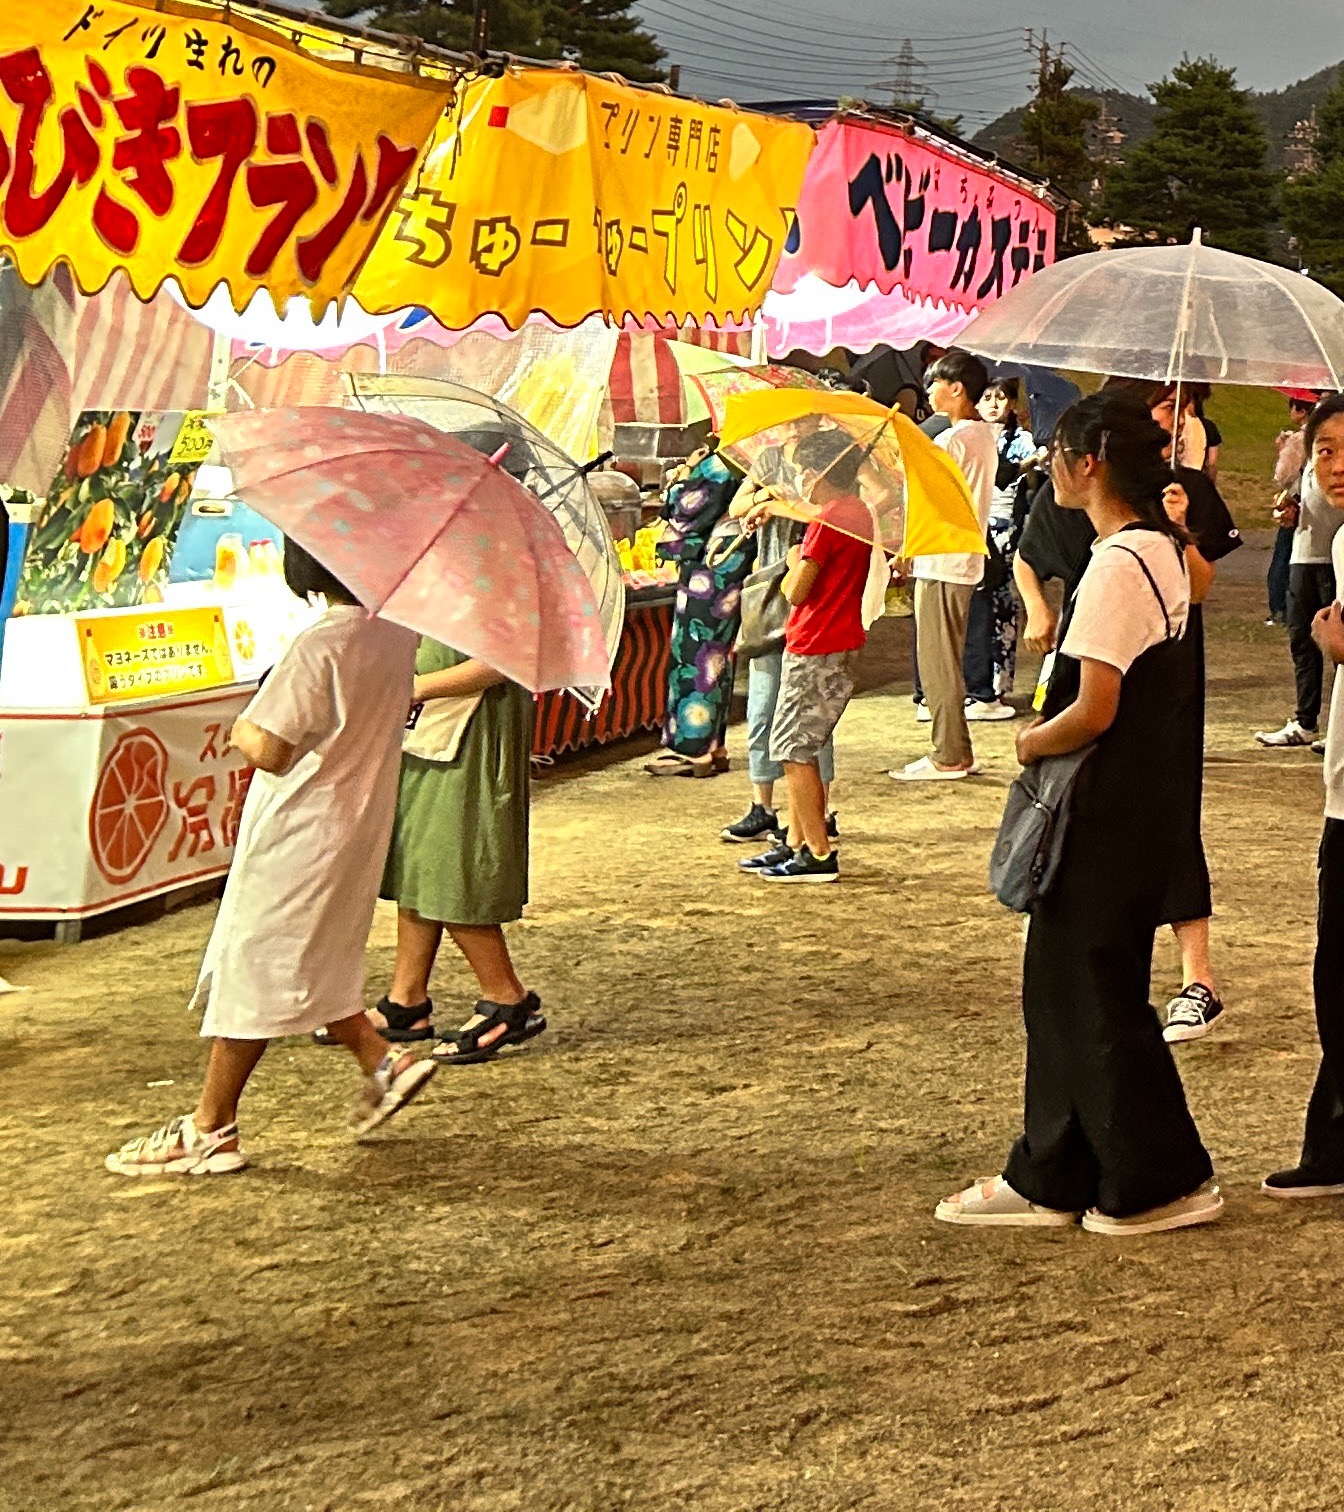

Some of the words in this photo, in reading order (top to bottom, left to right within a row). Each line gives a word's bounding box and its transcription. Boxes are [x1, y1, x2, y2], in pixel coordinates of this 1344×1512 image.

[63, 3, 277, 89] ドイツ生れの
[0, 46, 417, 286] びきフラン
[600, 100, 722, 174] プリン専門店
